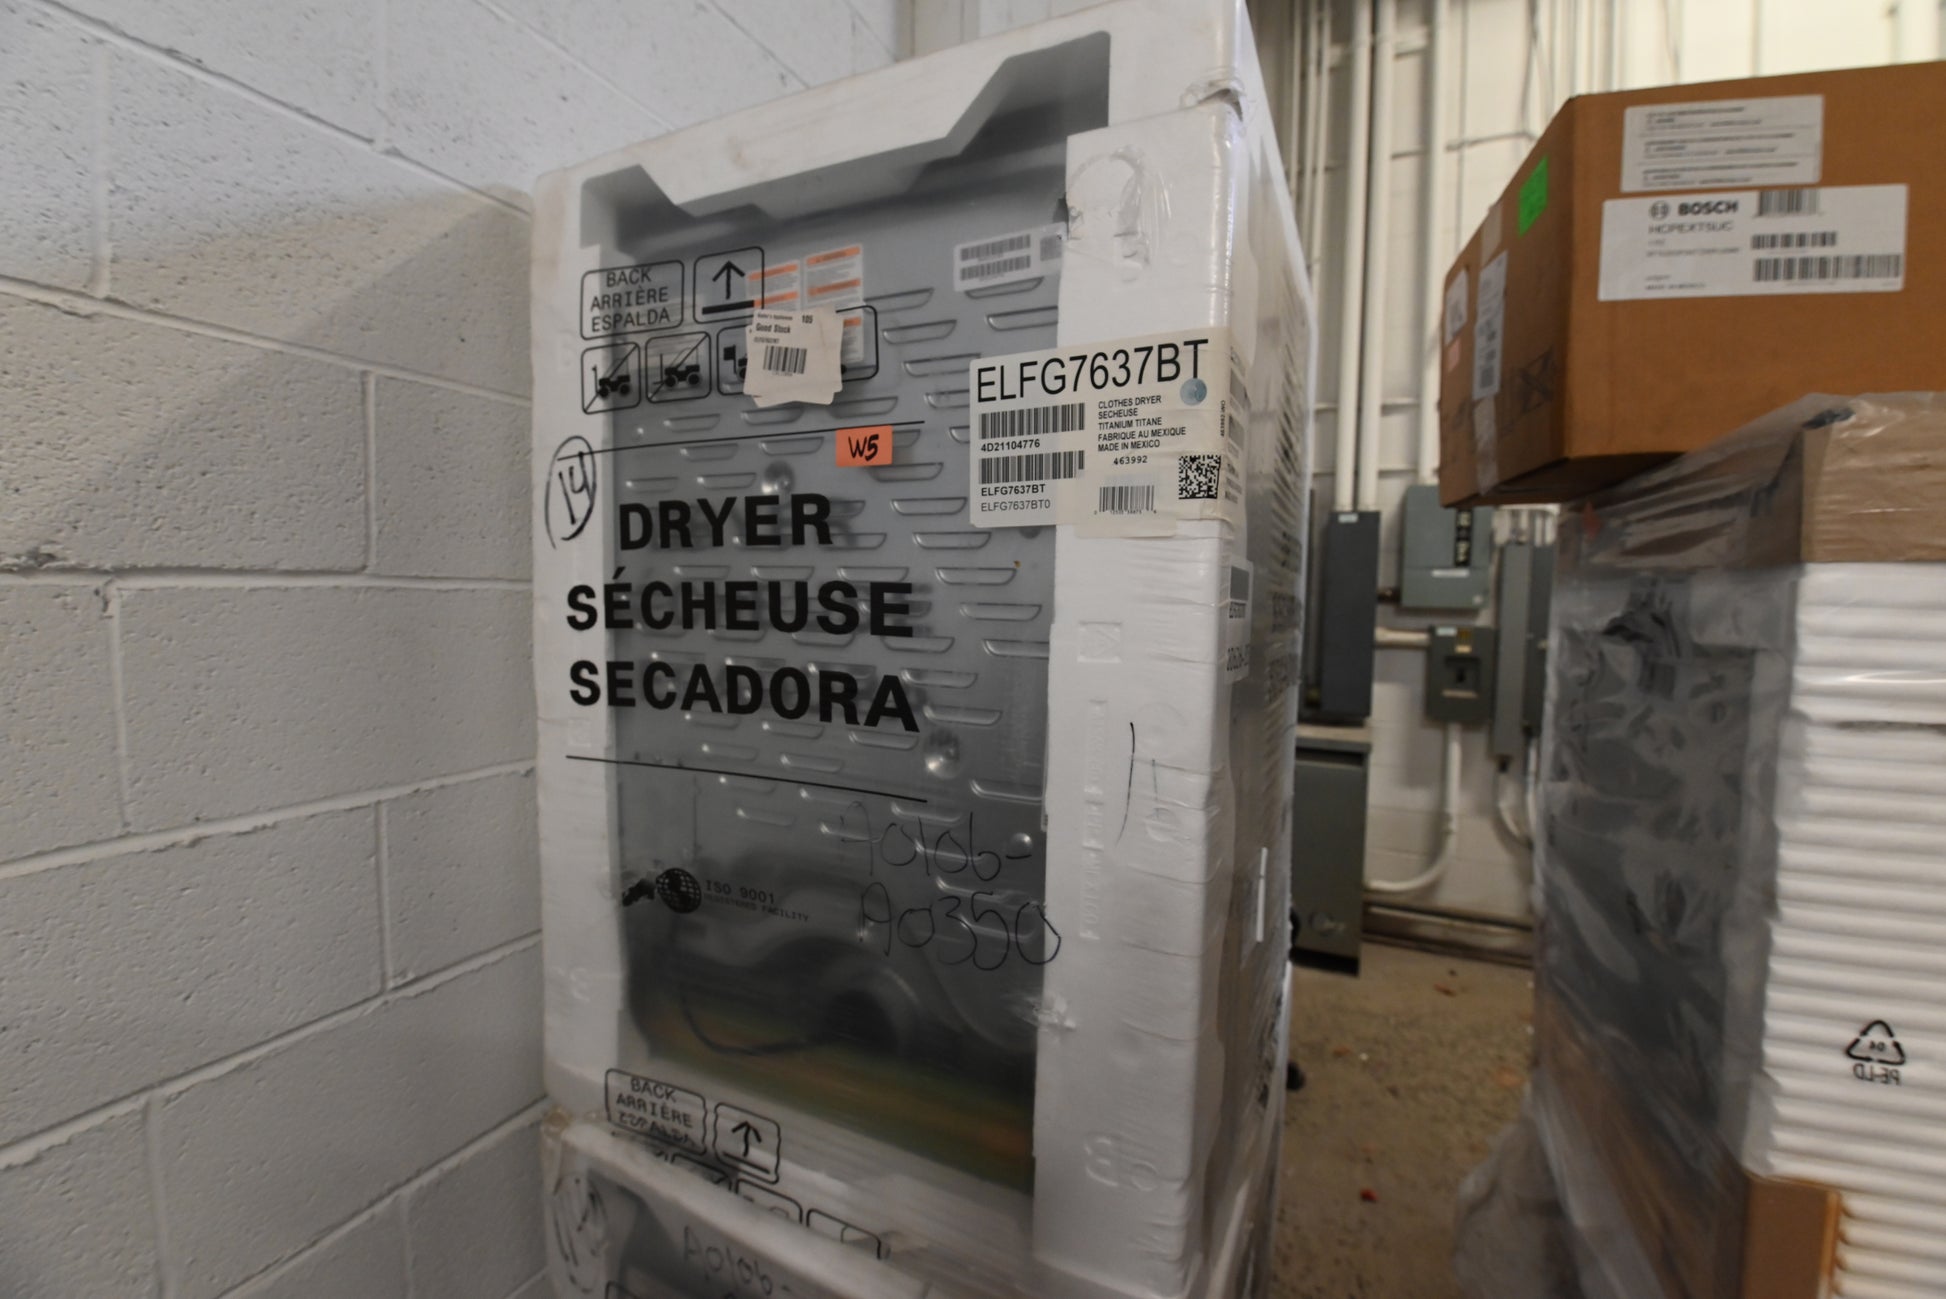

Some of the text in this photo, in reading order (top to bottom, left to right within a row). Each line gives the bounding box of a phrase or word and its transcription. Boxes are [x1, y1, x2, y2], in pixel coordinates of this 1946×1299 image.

[1678, 200, 1739, 216] BOSCH
[606, 266, 652, 288] BACK
[590, 285, 669, 312] ARRIÈRE
[591, 307, 671, 333] ESPALDA
[977, 339, 1209, 402] ELFG7637BT
[1098, 395, 1162, 410] CLOTHES DRYER
[1098, 408, 1138, 420] SECHEUSE
[1098, 417, 1162, 431] TITANIUM TITANE
[1098, 426, 1186, 442] FABRIQUE AU MEXIQUE
[849, 435, 880, 461] W5
[981, 438, 1041, 452] 4D21104776
[1098, 439, 1161, 452] MADE IN MEXICO
[1113, 455, 1148, 465] 463992
[981, 483, 1046, 497] ELFG7637BT
[980, 499, 1051, 512] ELFG7637BT0
[618, 493, 833, 551] DRYER
[566, 566, 914, 638] SÉCHEUSE
[569, 660, 920, 733] SECADORA
[706, 880, 775, 905] ISO 9001
[761, 904, 809, 922] FACILITY
[631, 1077, 677, 1103] BACK
[616, 1092, 693, 1128] ARRIÈRE
